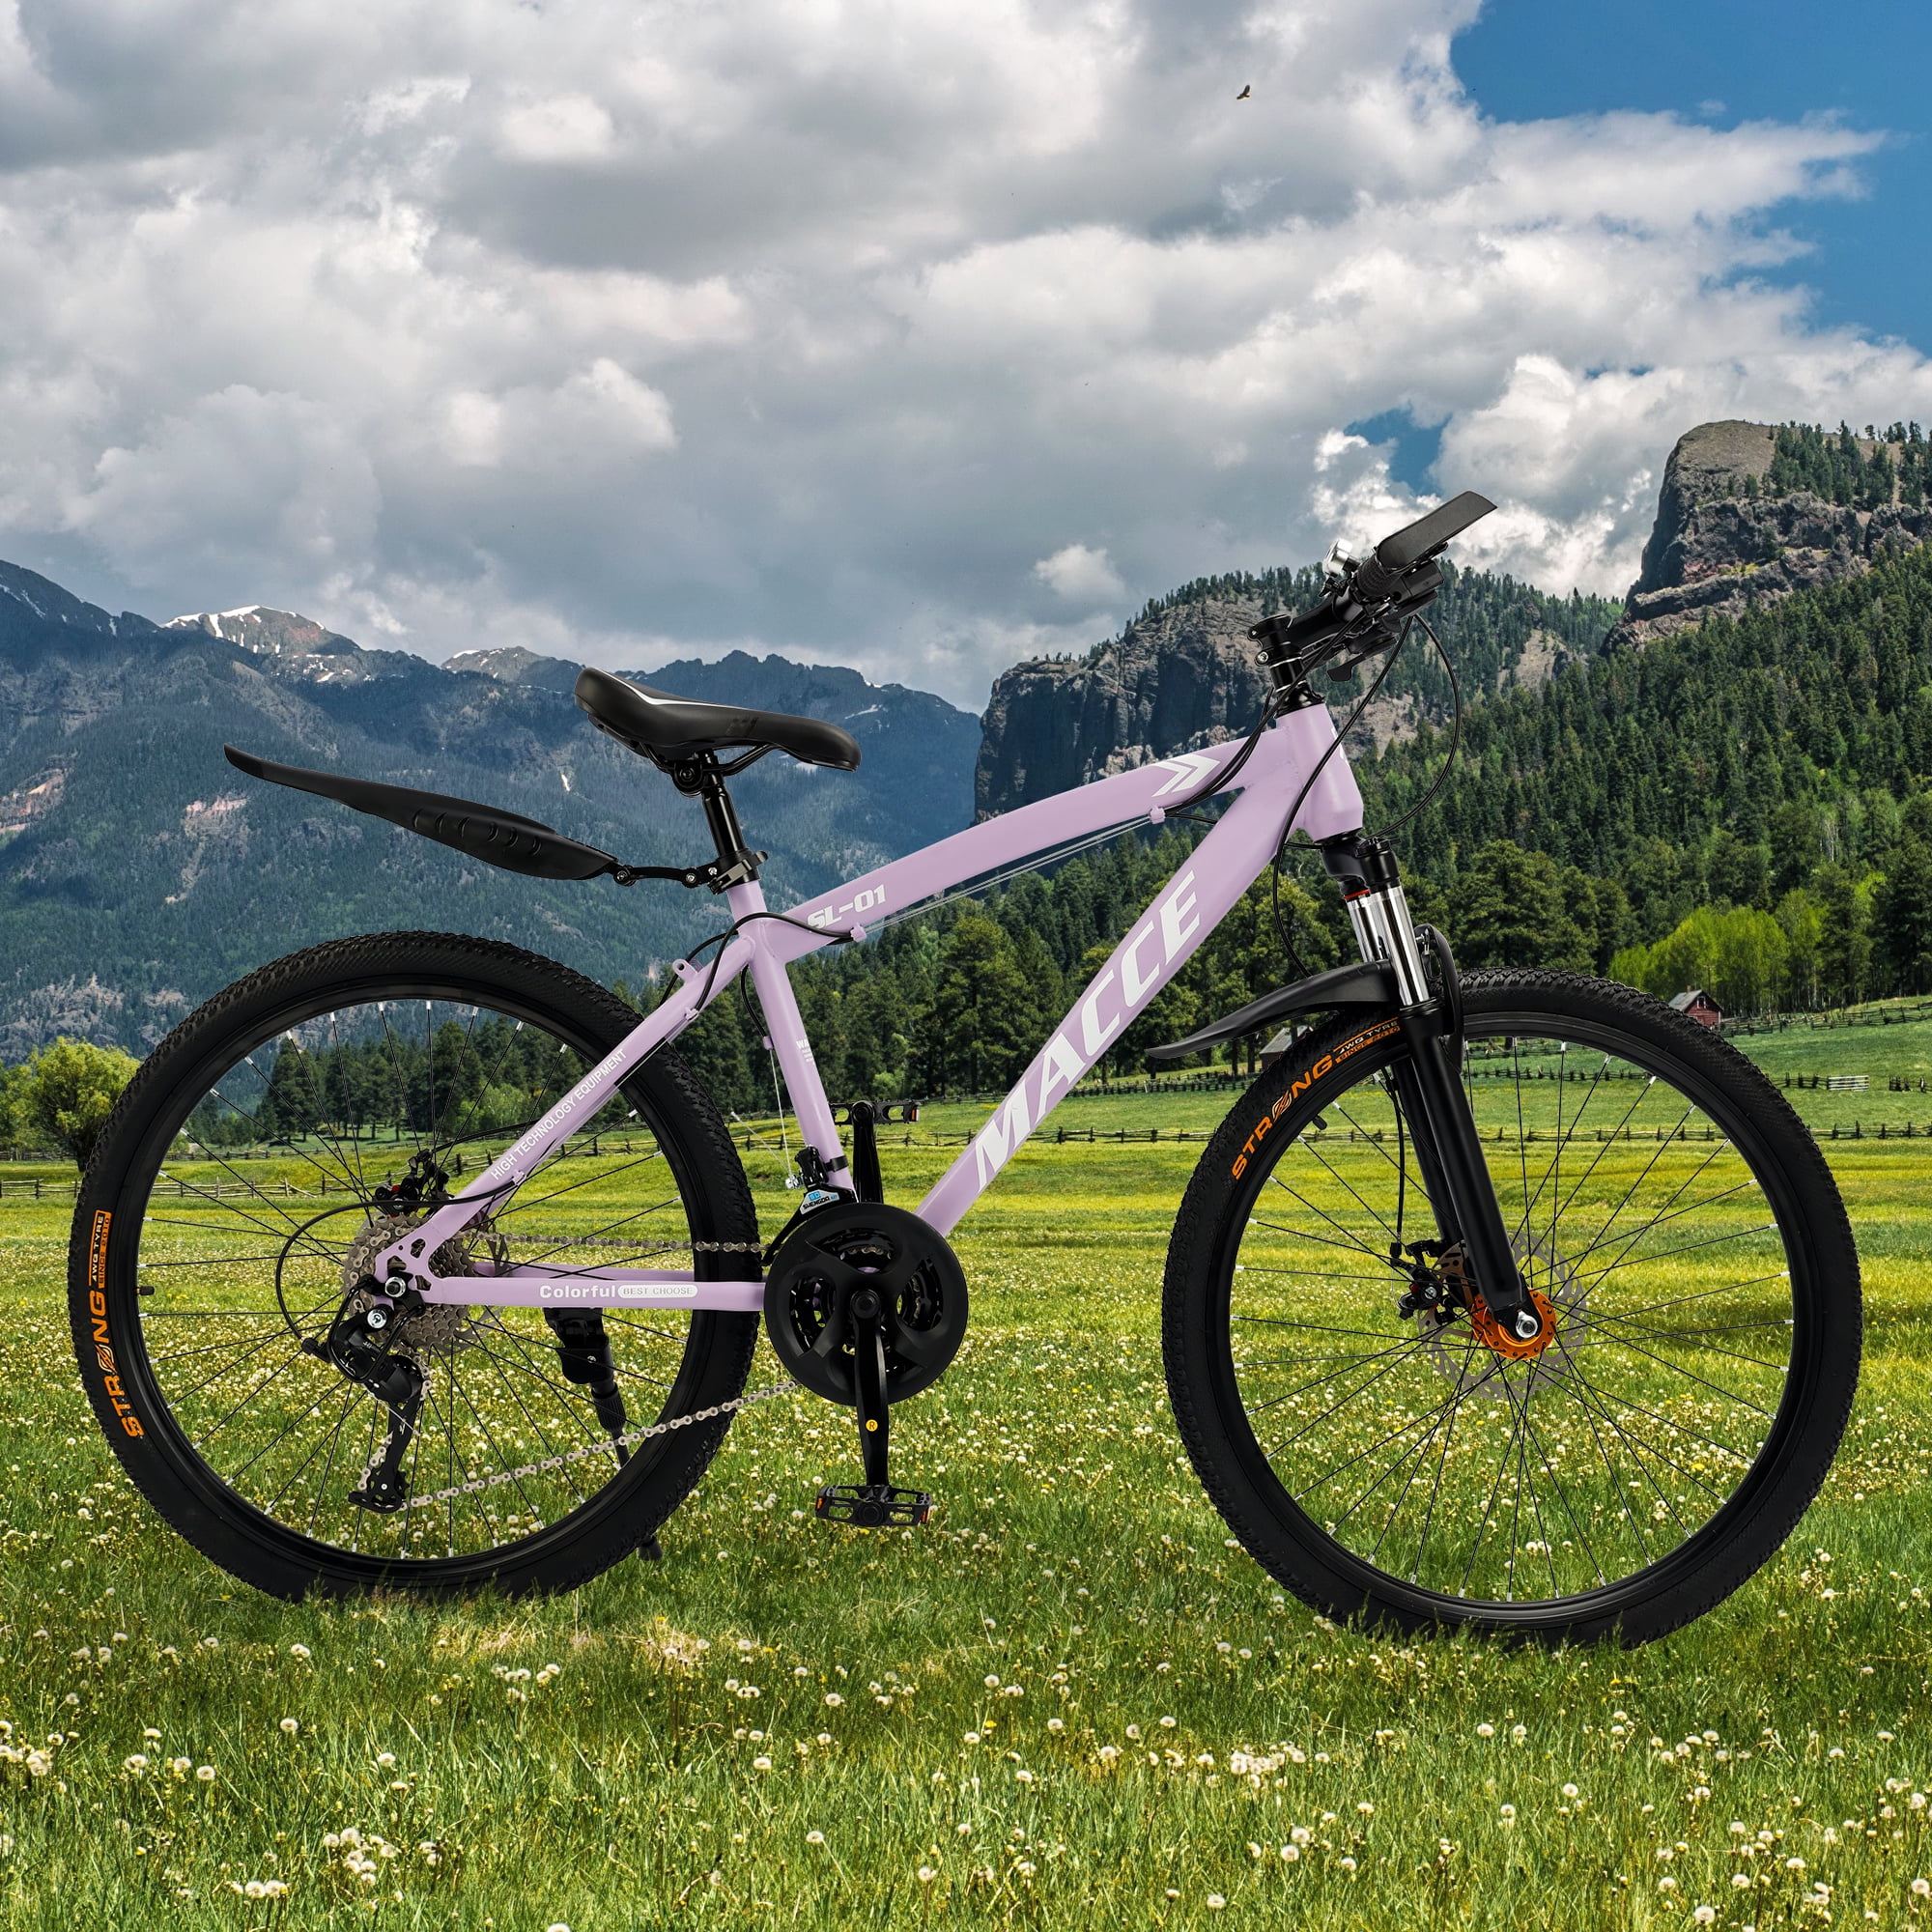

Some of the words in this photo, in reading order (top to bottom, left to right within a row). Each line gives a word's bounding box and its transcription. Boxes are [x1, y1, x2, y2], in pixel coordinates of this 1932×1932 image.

[808, 884, 886, 928] SL-01
[976, 869, 1200, 1192] MACCE
[491, 1154, 517, 1180] HIGH
[514, 1097, 577, 1157] TECHNOLOGY
[574, 1048, 627, 1100] EQUIPMENT
[93, 1215, 104, 1250] TYRE
[539, 1285, 615, 1298] Colorful
